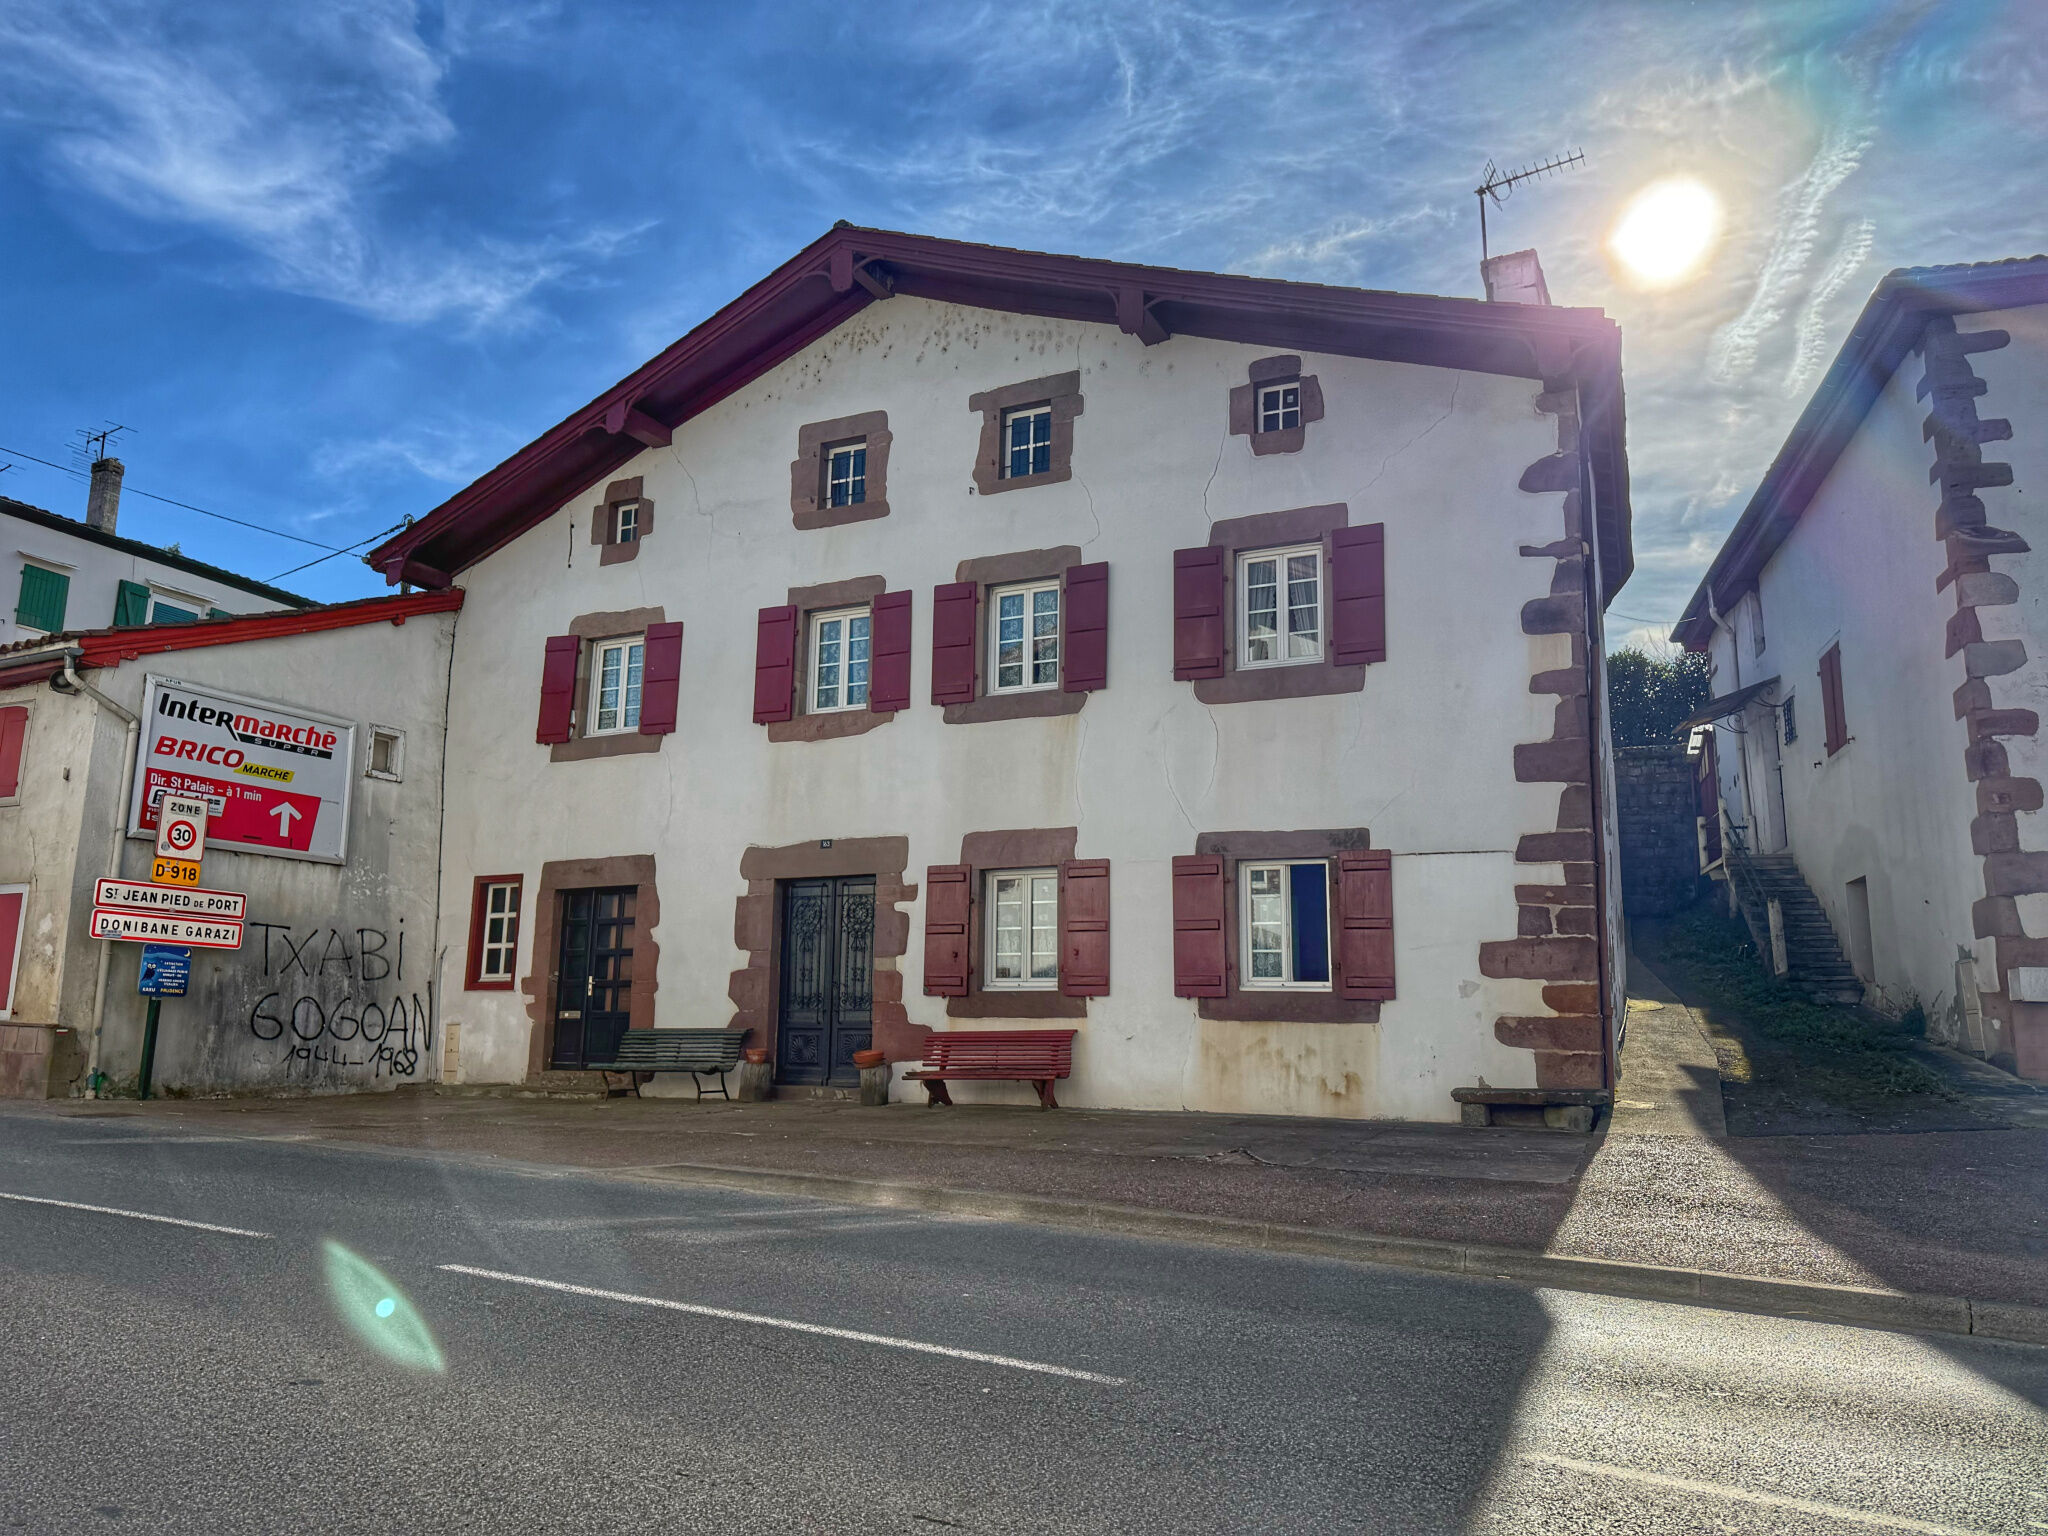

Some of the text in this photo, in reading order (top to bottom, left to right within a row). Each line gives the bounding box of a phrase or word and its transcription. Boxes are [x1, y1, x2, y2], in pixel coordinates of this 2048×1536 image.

[158, 692, 337, 751] Intermarché
[154, 736, 244, 768] BRICO
[254, 737, 318, 756] SUPER
[150, 773, 167, 787] Dir.
[170, 776, 182, 789] St
[184, 778, 214, 794] Palais
[226, 785, 232, 797] à
[235, 787, 240, 798] 1
[244, 789, 262, 802] min
[170, 802, 201, 816] ZONE
[173, 828, 191, 842] 30
[123, 890, 158, 904] JEAN
[161, 894, 190, 907] PIED
[194, 900, 204, 908] DE
[208, 898, 239, 912] PORT
[101, 918, 235, 940] DONIBANE GARAZI
